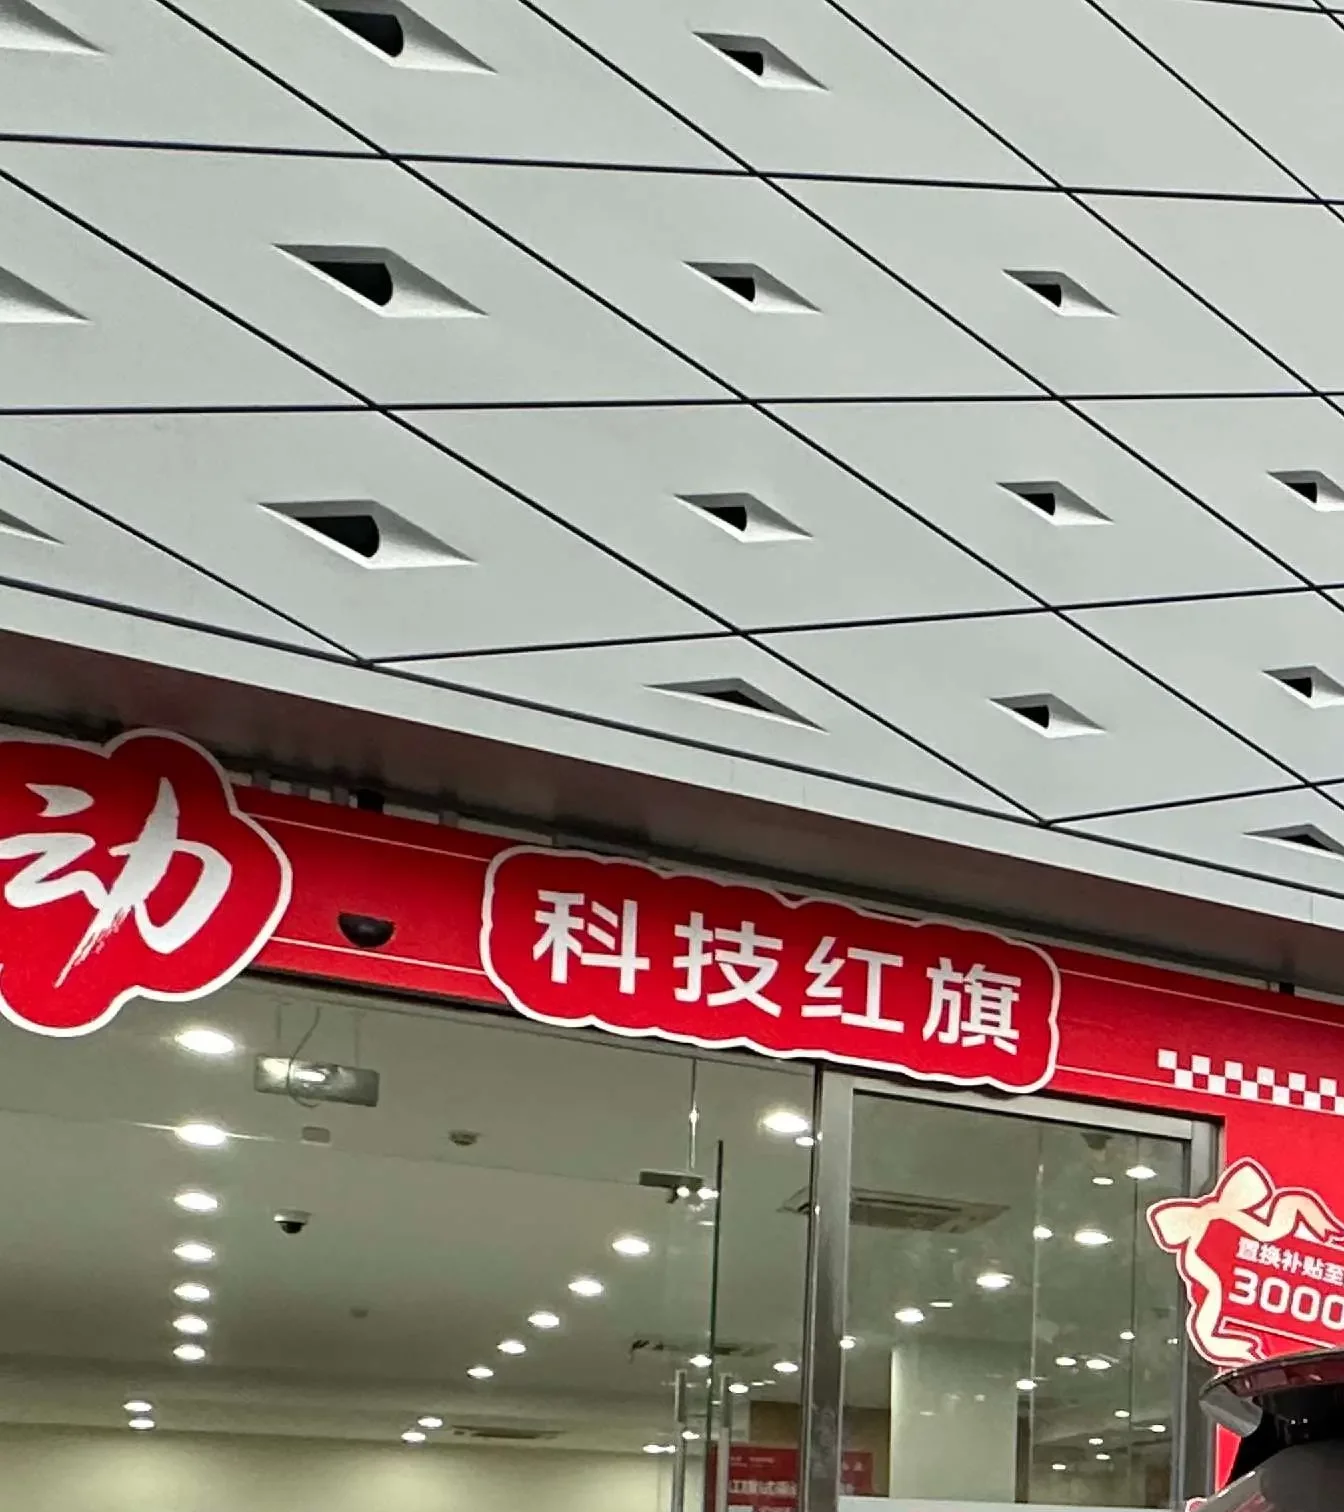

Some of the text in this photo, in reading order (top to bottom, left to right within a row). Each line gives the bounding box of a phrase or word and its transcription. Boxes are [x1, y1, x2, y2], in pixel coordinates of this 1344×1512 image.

[0, 777, 232, 989] 动
[533, 889, 1022, 1056] 科技红旗
